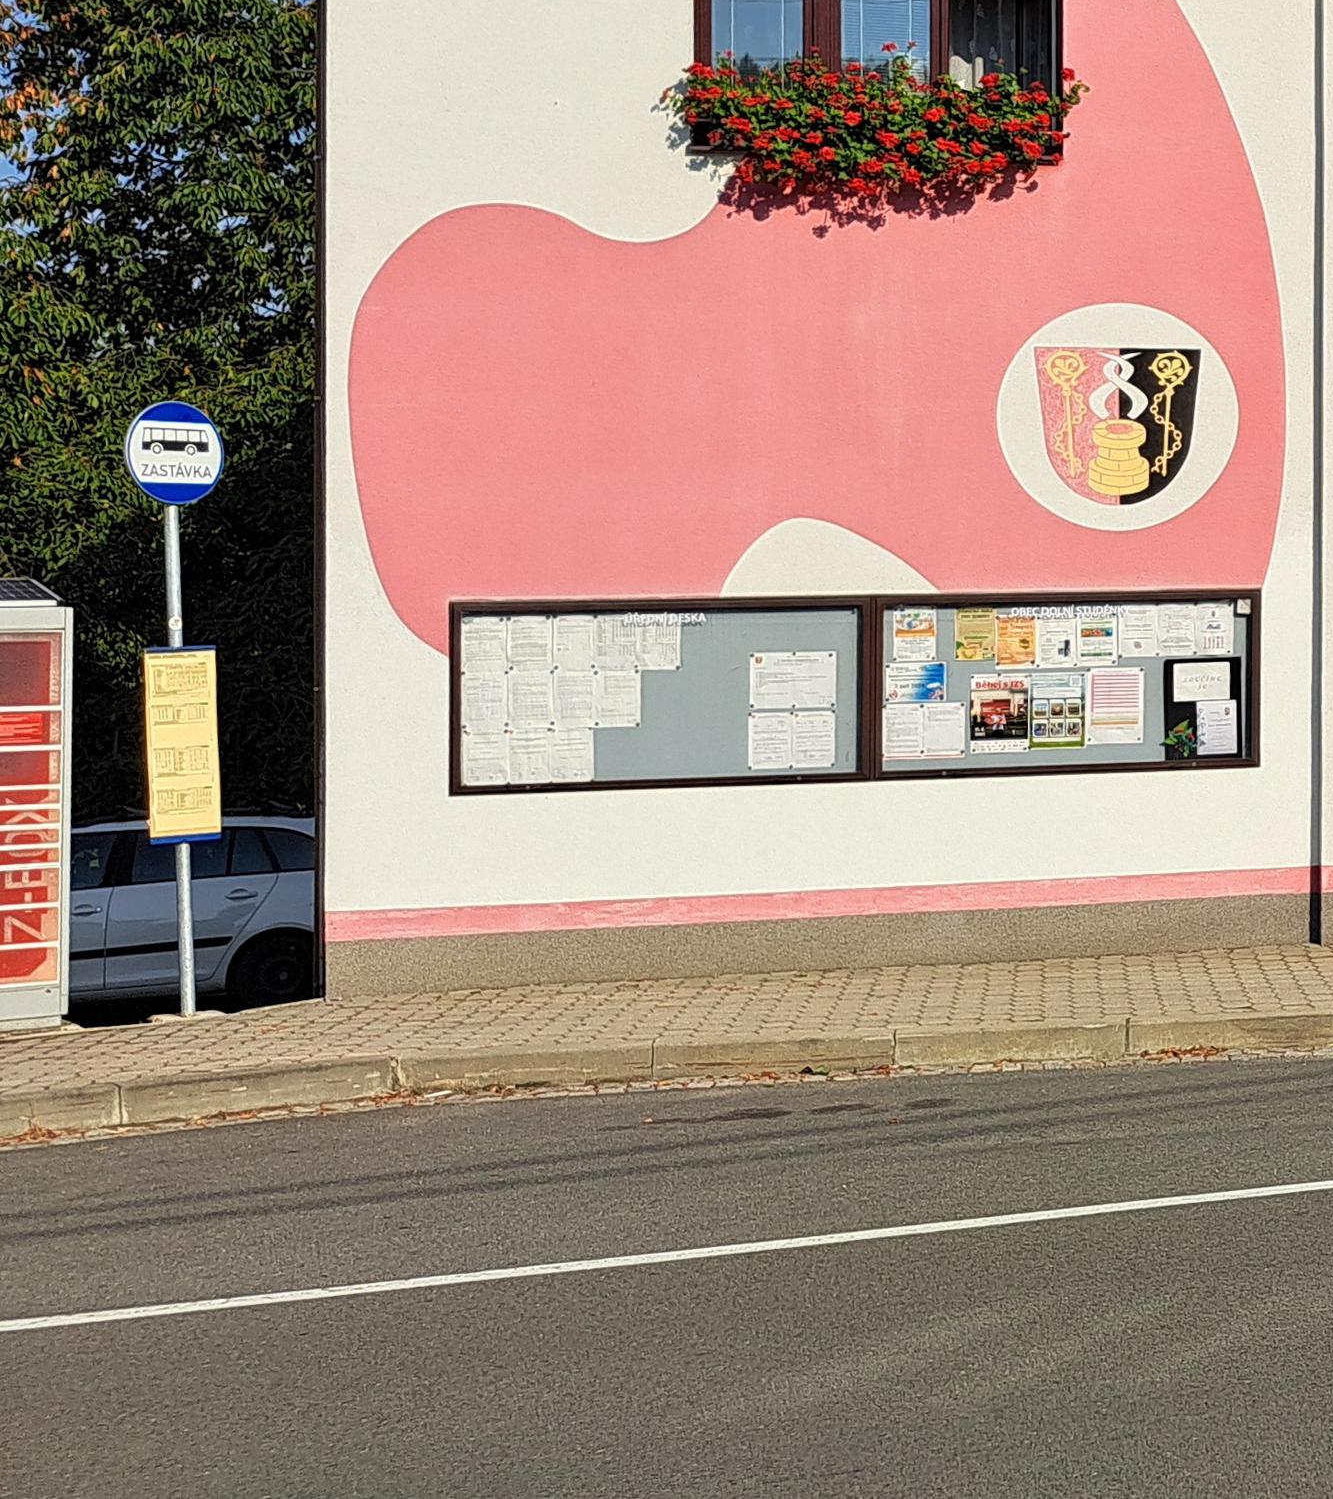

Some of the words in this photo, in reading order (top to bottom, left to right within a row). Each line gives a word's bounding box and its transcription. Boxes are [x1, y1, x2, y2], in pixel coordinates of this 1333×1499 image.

[141, 462, 212, 478] ZASTÁVKA
[623, 611, 668, 623] ÚŘEDNÍ
[669, 612, 707, 623] DESKA
[1010, 607, 1040, 616] OBEC
[1041, 604, 1074, 615] DOLNÍ
[4, 797, 49, 944] Z-BOX
